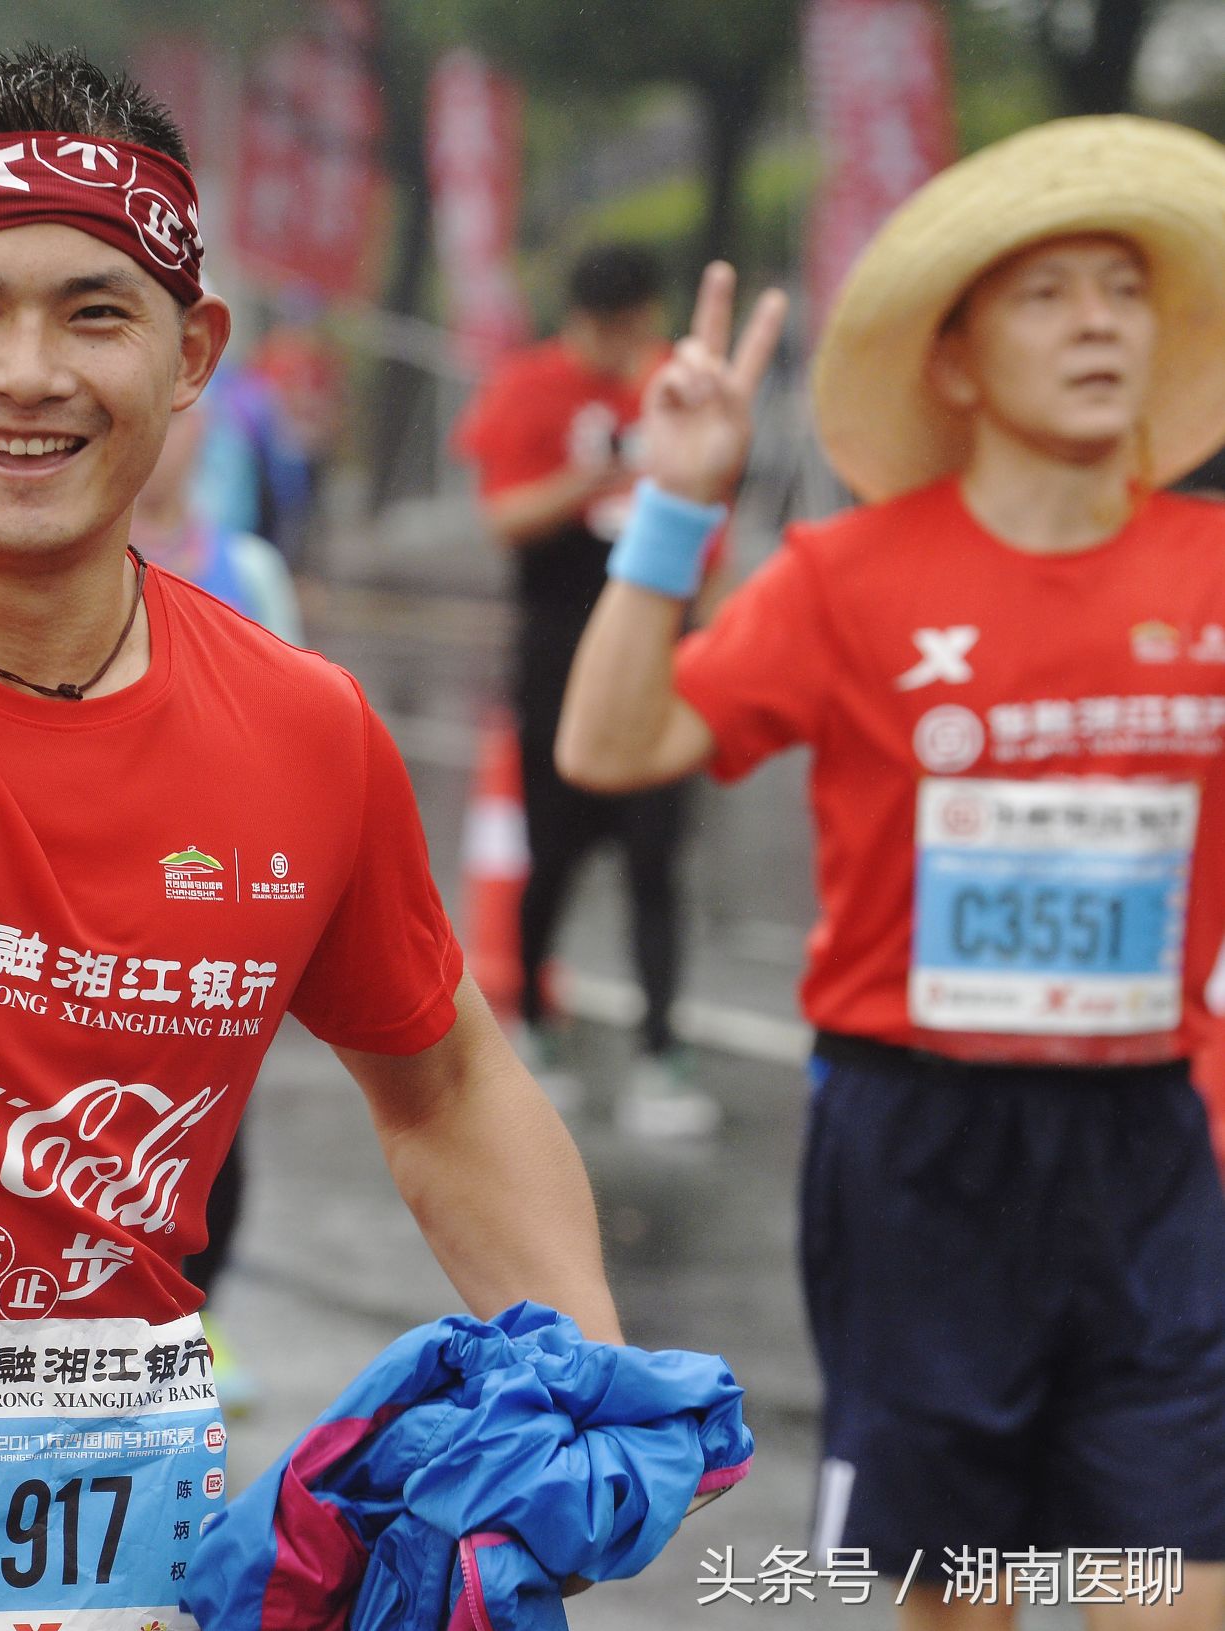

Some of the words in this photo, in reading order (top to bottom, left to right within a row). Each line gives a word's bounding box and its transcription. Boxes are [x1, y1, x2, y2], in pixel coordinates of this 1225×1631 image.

[165, 889, 216, 898] CHANGSHA
[948, 884, 1125, 966] C3551
[58, 1006, 213, 1038] XIANGJIANG
[216, 1016, 264, 1038] BANK
[53, 1388, 164, 1411] XIANGJIANG
[168, 1381, 216, 1404] BANK
[43, 1450, 125, 1460] INTERNATIONAL
